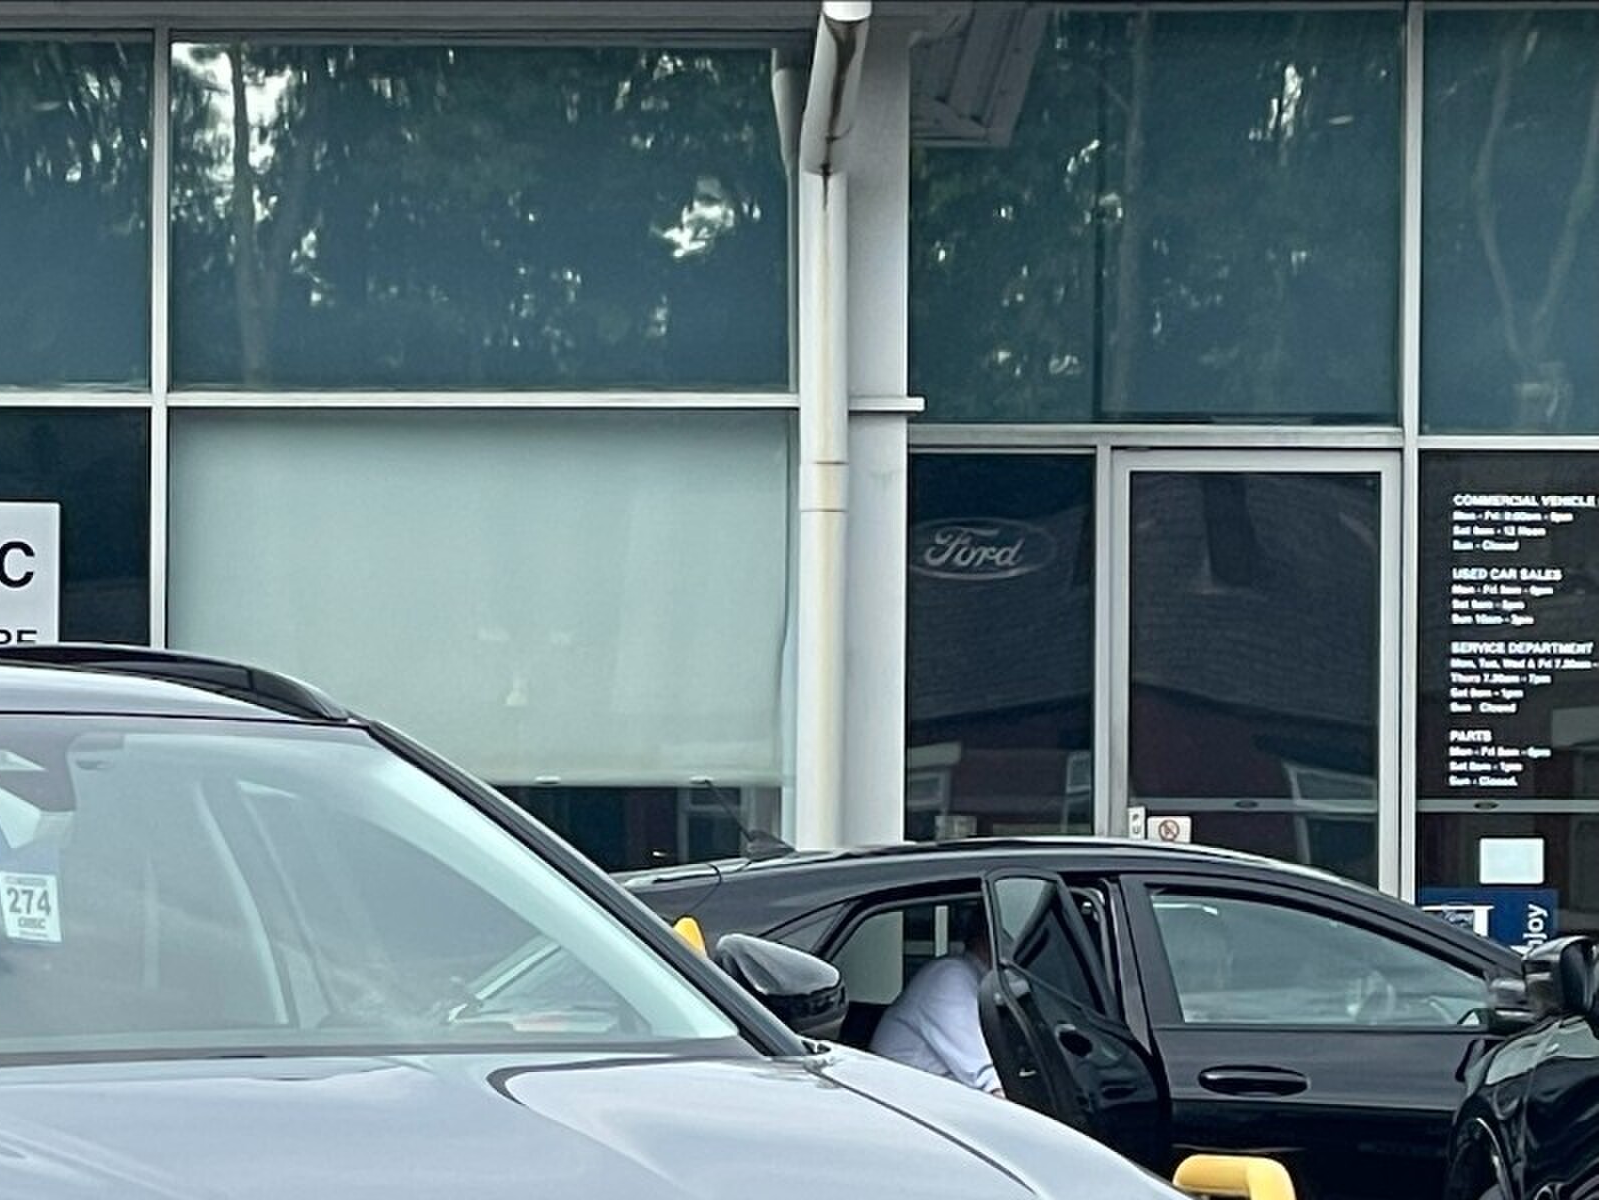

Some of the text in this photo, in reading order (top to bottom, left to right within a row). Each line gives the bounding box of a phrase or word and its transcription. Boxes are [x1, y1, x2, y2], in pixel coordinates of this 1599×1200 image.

[1452, 493, 1540, 507] COMMERCIAL
[1540, 495, 1596, 508] VEHICLE
[924, 526, 1025, 566] Ford
[1452, 567, 1563, 581] USED CAR SALES
[1451, 641, 1594, 655] SERVICE DEPARTMENT
[1449, 729, 1492, 743] PARTS
[6, 887, 52, 916] 274
